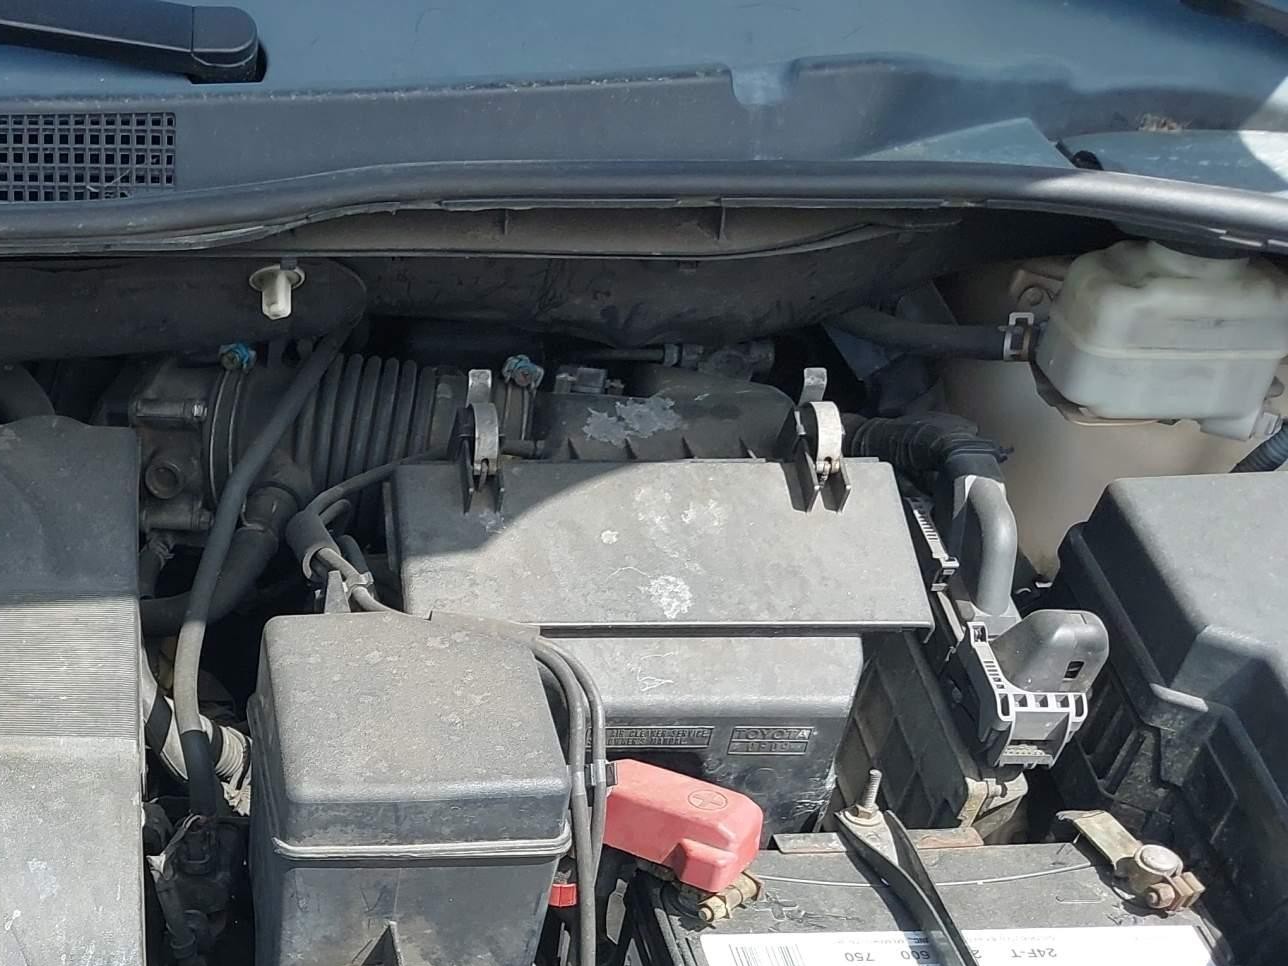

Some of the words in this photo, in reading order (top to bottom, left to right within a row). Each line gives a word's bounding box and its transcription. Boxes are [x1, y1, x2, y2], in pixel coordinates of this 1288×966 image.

[733, 728, 811, 740] TOYOTA
[844, 951, 877, 963] 750
[900, 949, 931, 961] 600
[1012, 947, 1057, 959] 24F-T
